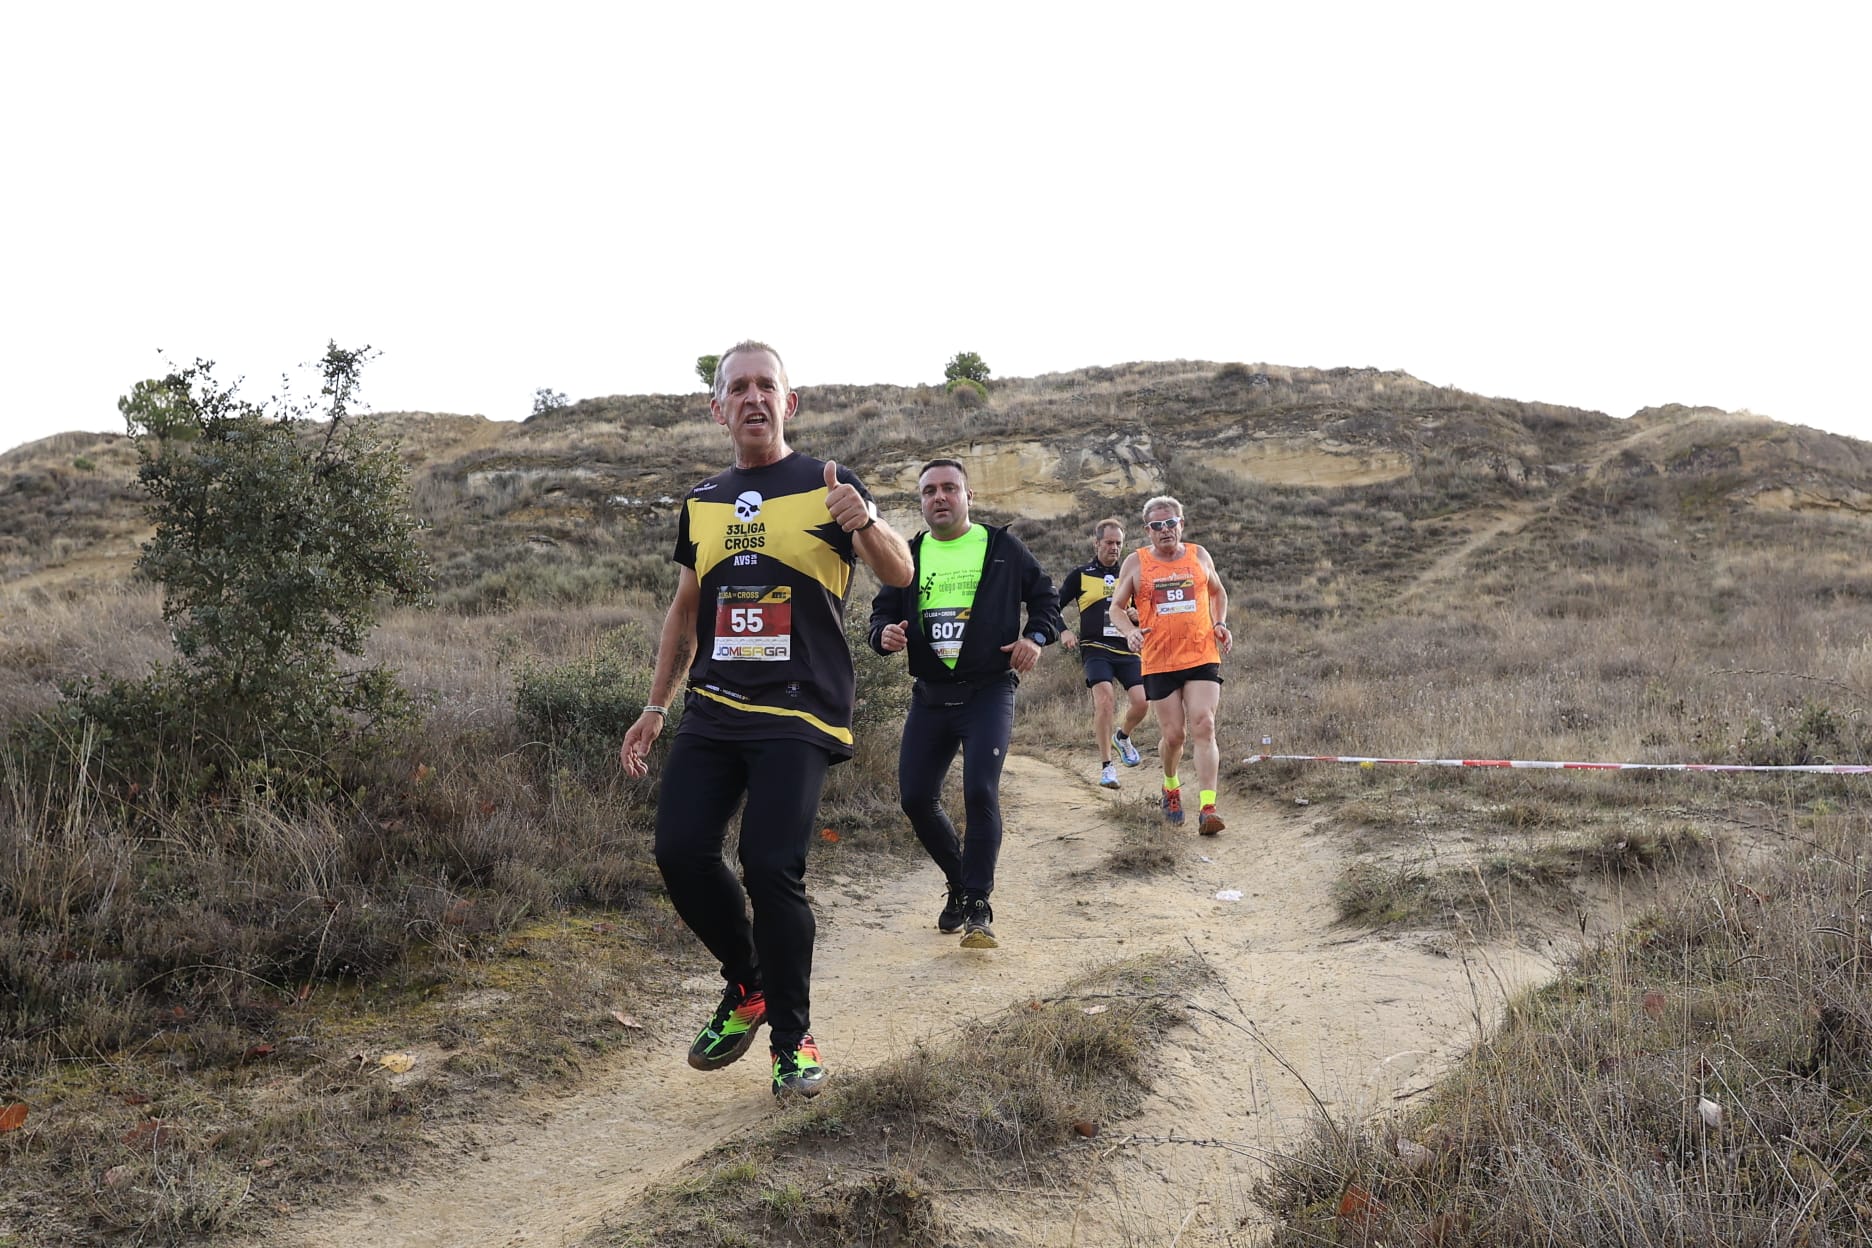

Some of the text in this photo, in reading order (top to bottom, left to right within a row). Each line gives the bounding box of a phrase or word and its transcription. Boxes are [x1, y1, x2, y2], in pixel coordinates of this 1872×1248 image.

[726, 522, 766, 536] 33LIGA
[724, 536, 766, 550] CROSS
[733, 555, 750, 566] AVS
[737, 591, 760, 599] CROSS
[1167, 589, 1184, 601] 58
[731, 608, 764, 632] 55
[931, 622, 965, 640] 607
[716, 646, 787, 656] JOMISAGA
